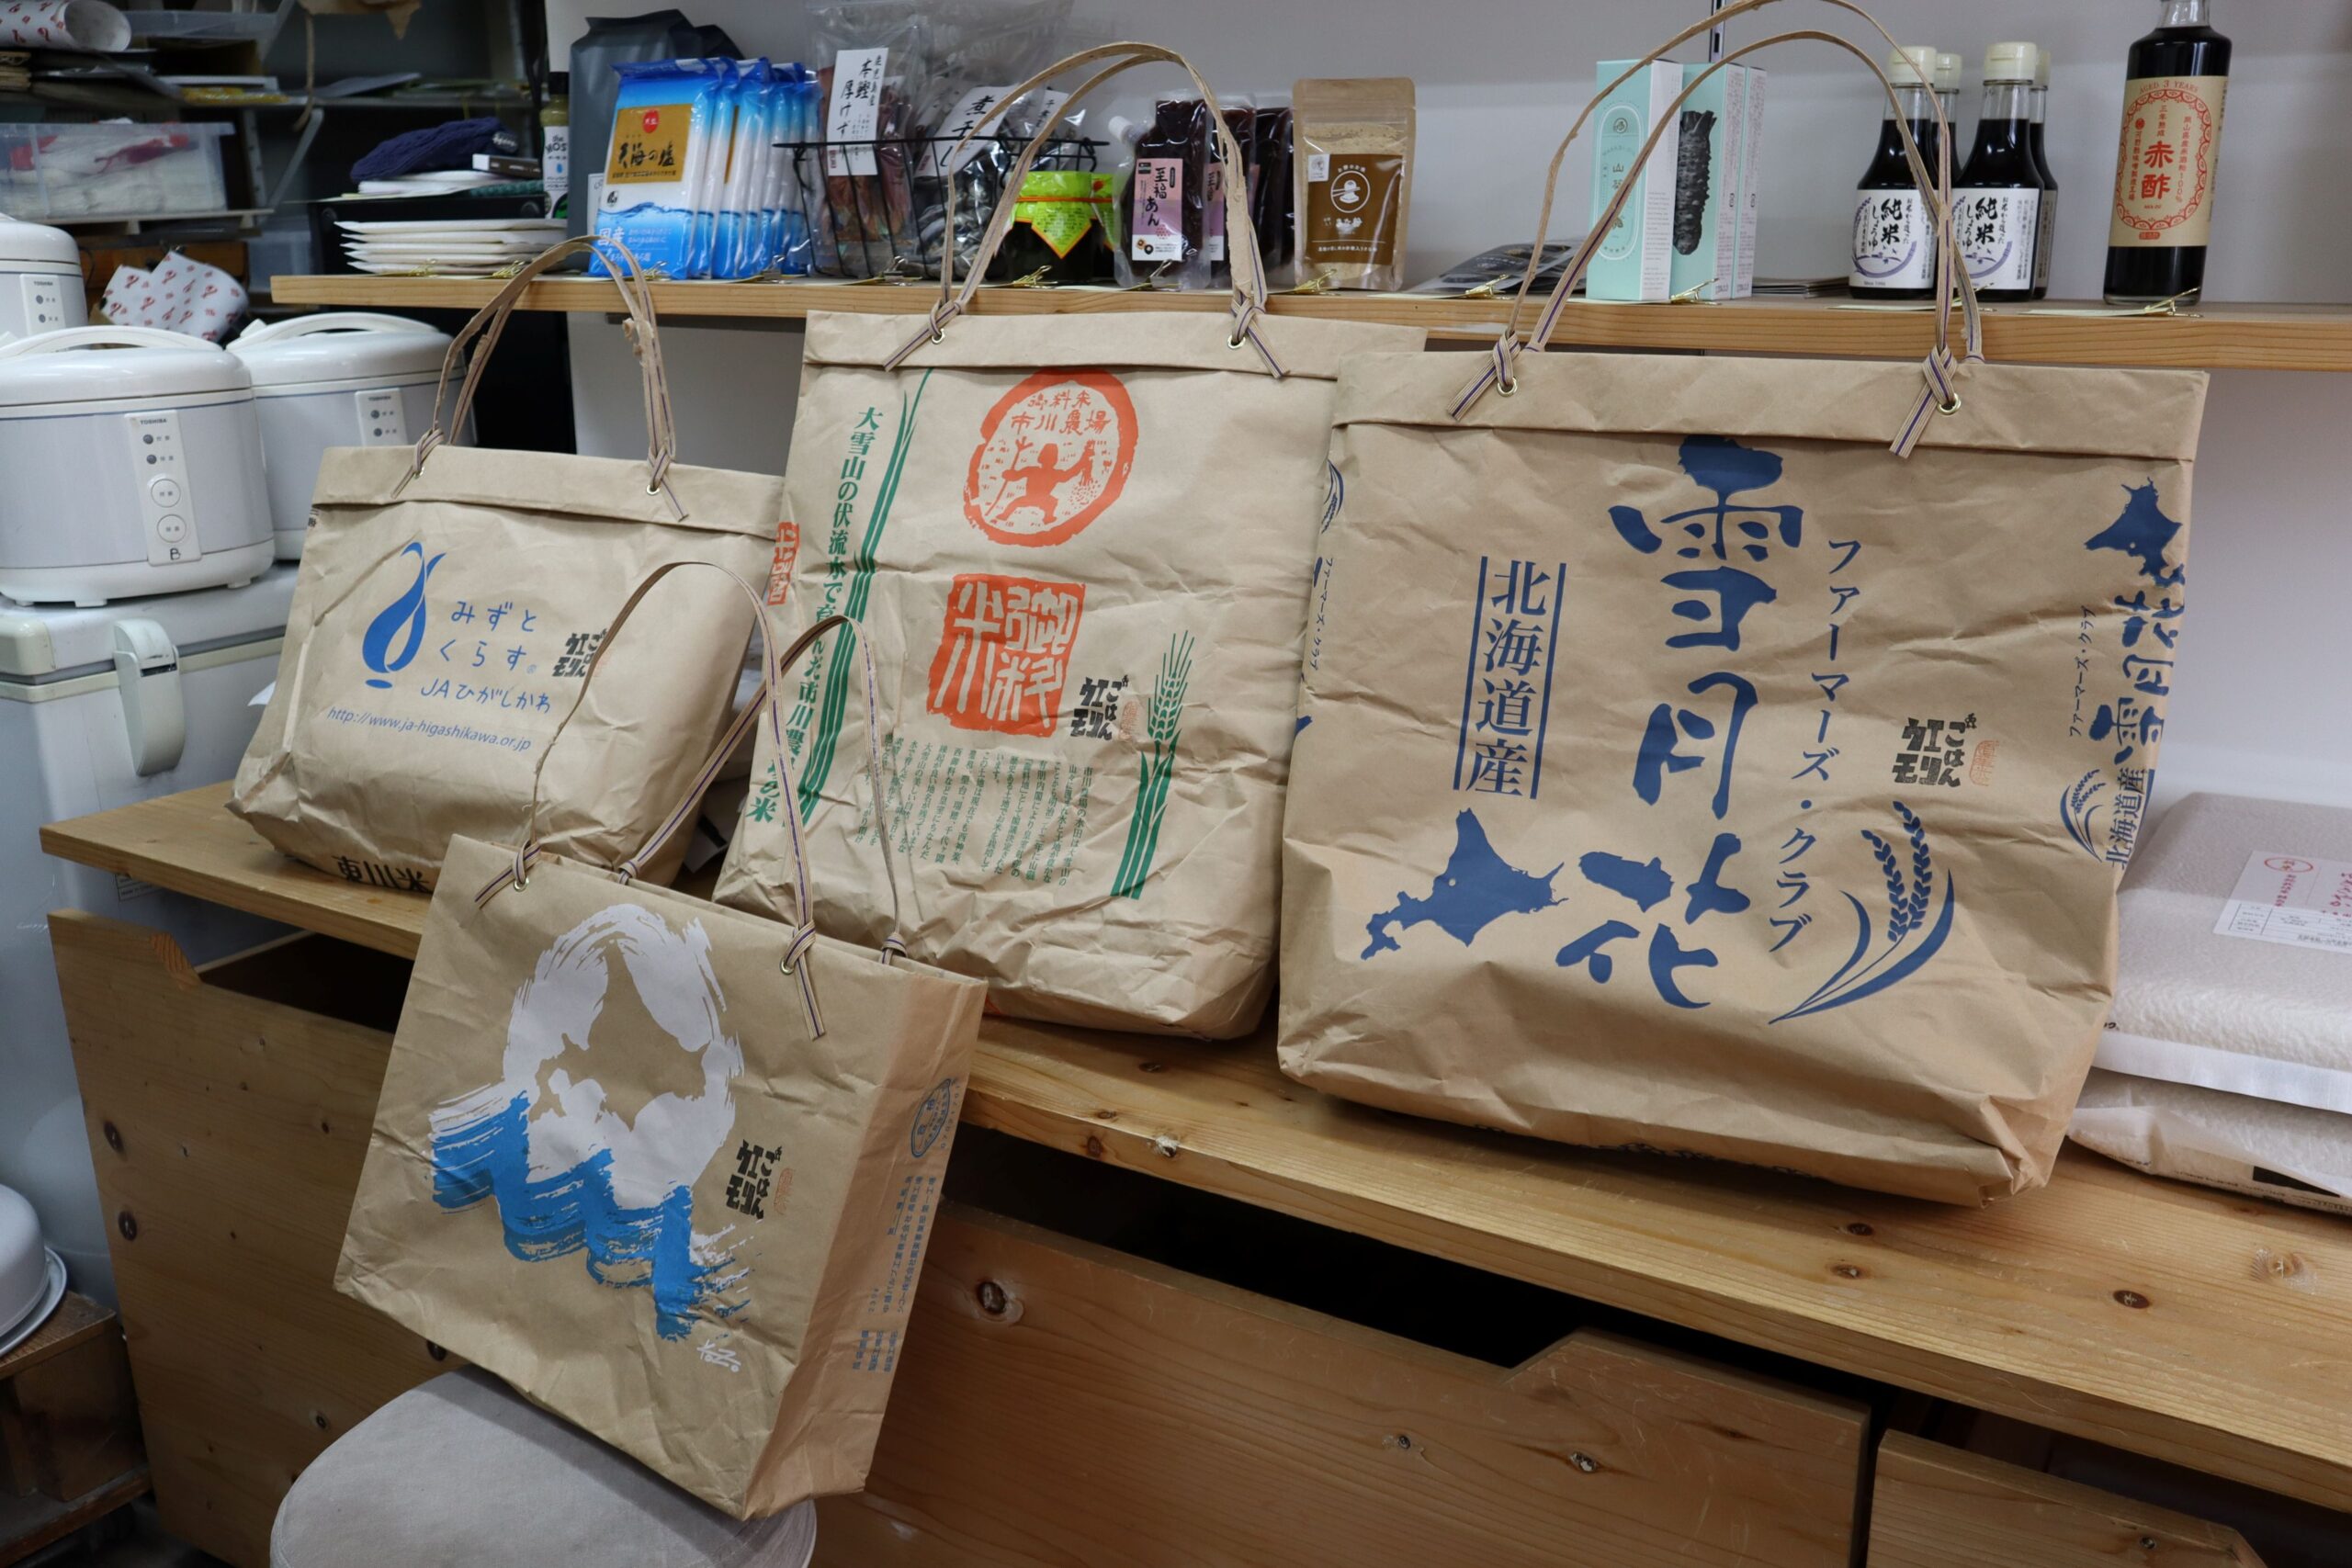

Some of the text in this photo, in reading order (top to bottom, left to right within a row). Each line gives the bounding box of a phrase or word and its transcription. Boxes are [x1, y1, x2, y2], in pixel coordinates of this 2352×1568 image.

[2140, 79, 2199, 93] AGED 3 YEARS
[2141, 141, 2175, 199] 赤酢
[1145, 167, 1169, 227] 至福あん
[1881, 197, 1904, 245] 純米
[1974, 197, 1998, 245] 純米
[1869, 204, 1881, 251] しょうゆ
[1962, 203, 1974, 251] しょうゆ
[1011, 409, 1112, 435] 市川農場
[451, 601, 537, 632] みずと
[745, 407, 883, 823] 大雪山の伏流水で育んだ市川農の米
[1466, 560, 1548, 797] 北海道産
[2070, 605, 2098, 737] ファーマーズ・クラブ
[327, 706, 531, 751] http://www.ja-higashikawa.or.jp
[1556, 435, 1804, 1009] 雪月花
[1770, 538, 1862, 953] ファーマーズ・クラブ
[2105, 766, 2149, 869] 北海道産
[331, 856, 434, 895] 東川米
